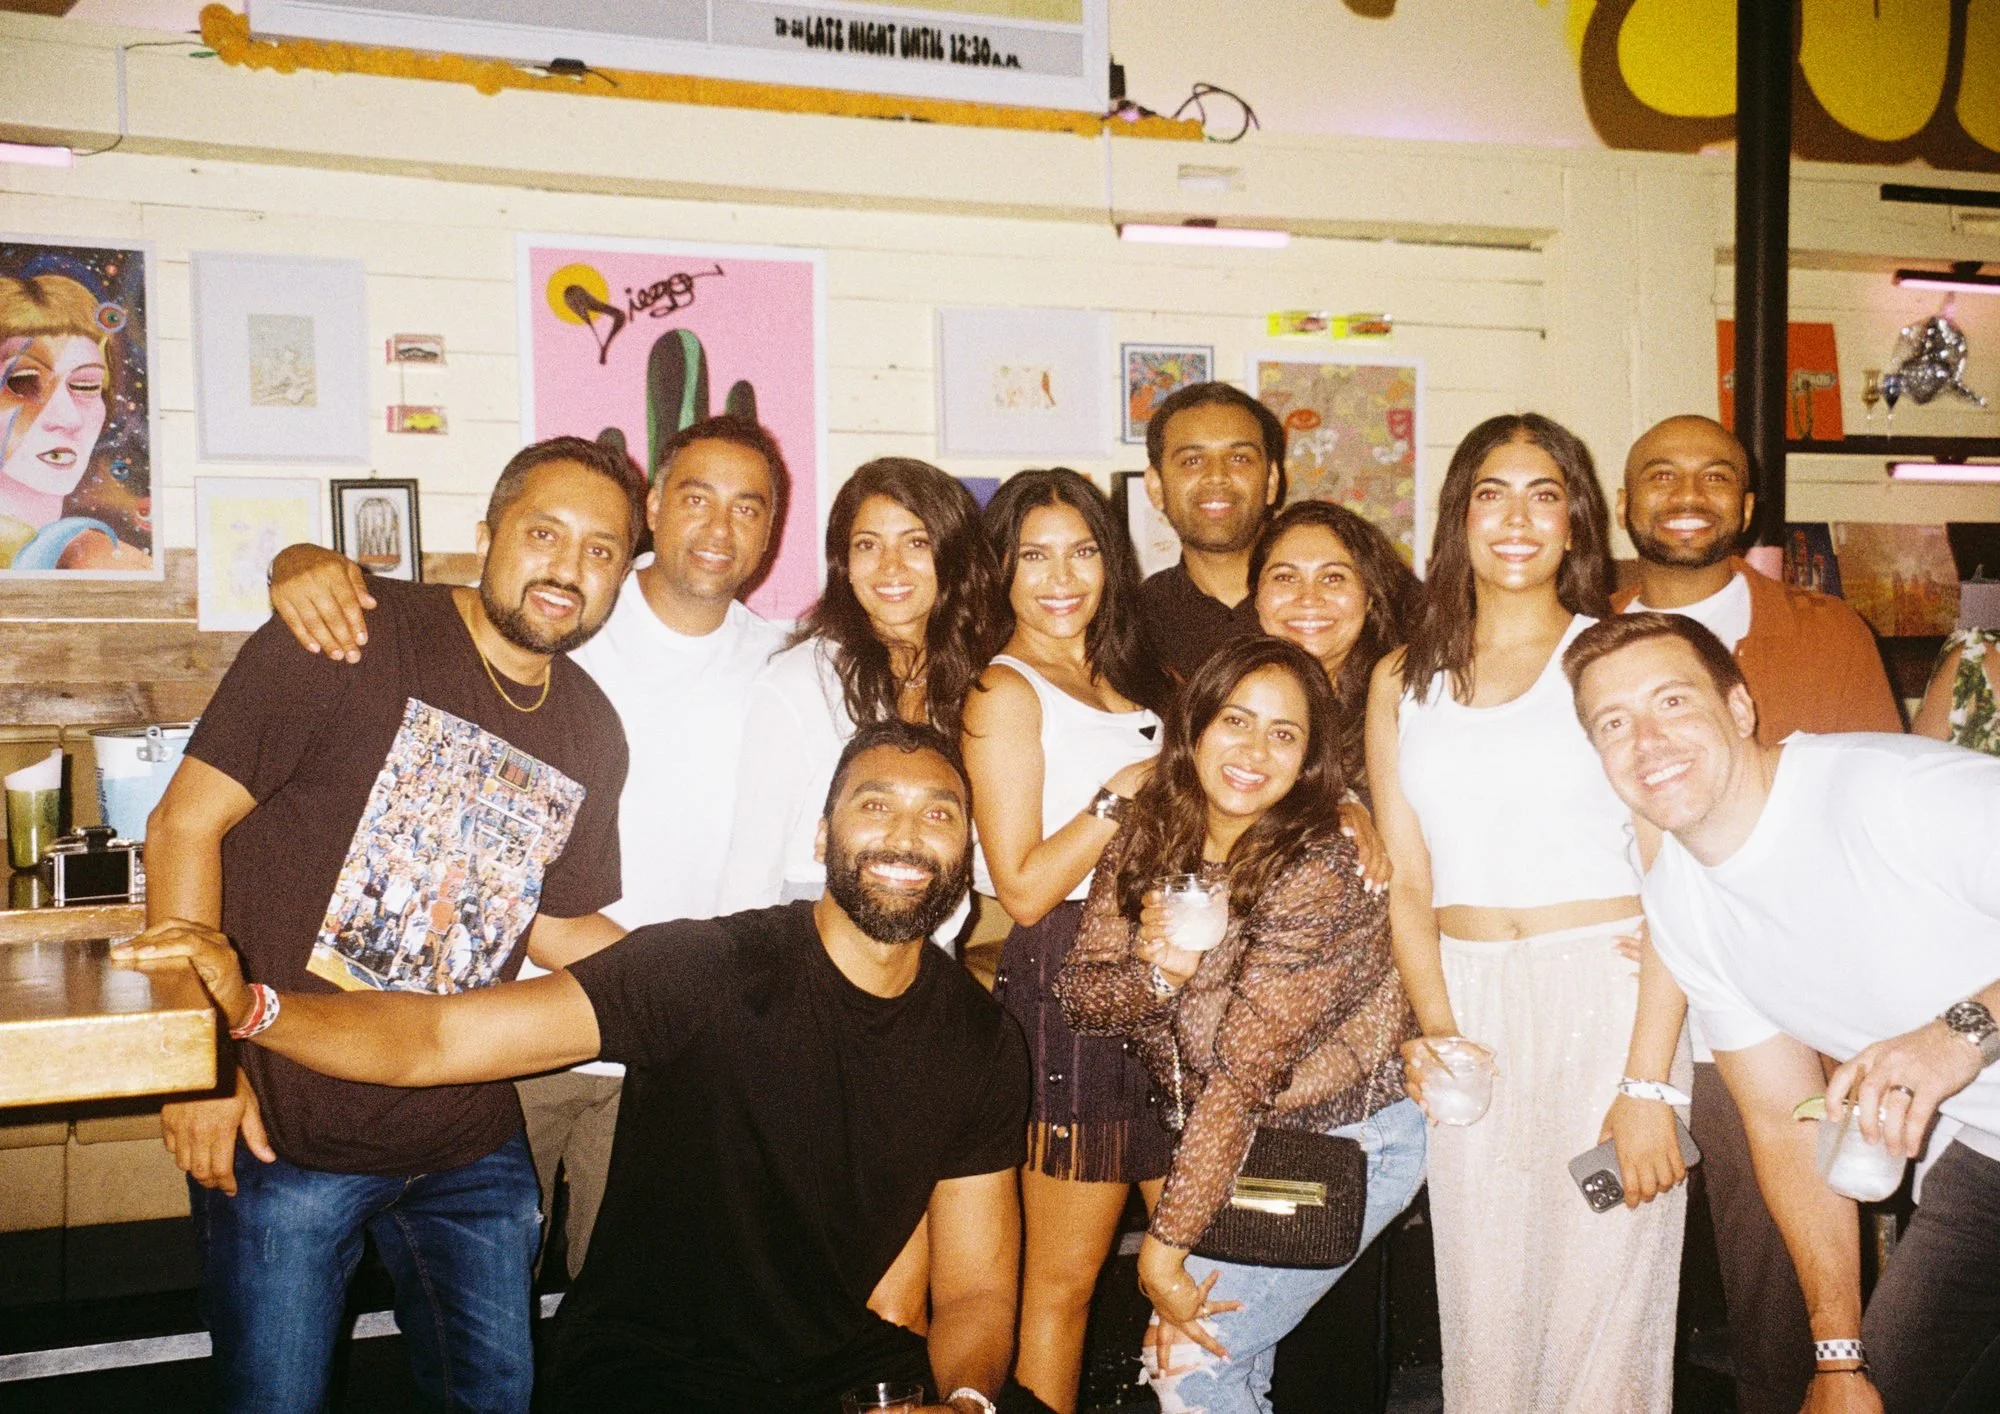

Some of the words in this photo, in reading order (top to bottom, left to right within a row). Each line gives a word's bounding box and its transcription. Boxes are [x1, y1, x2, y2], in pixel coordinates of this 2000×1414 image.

[806, 16, 844, 51] LATE
[848, 21, 896, 57] NIGHT
[900, 26, 945, 60] UNTIL
